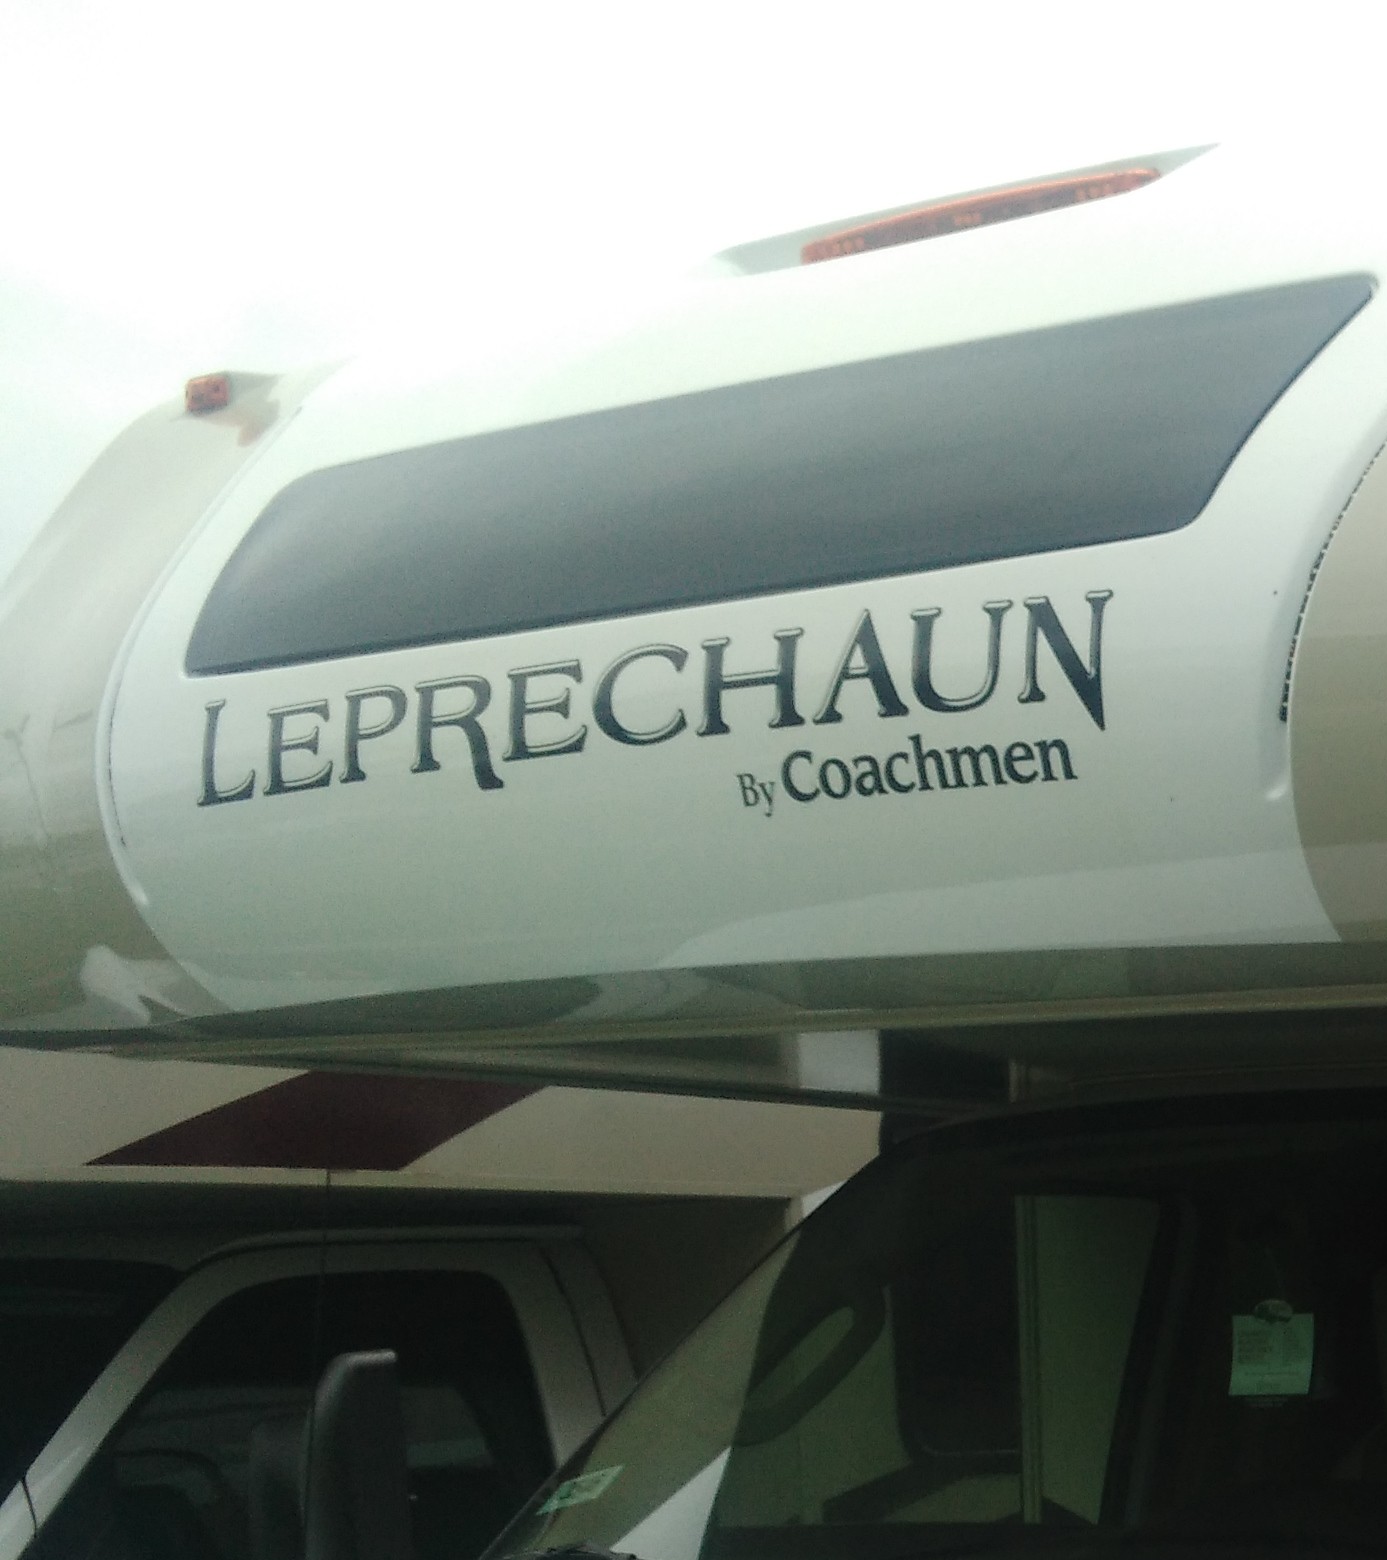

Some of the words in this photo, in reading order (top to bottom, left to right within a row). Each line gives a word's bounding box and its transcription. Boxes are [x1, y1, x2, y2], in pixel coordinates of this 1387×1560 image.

[197, 589, 1114, 807] LEPRECHAUN
[736, 772, 777, 818] By
[780, 733, 1079, 804] Coachmen
